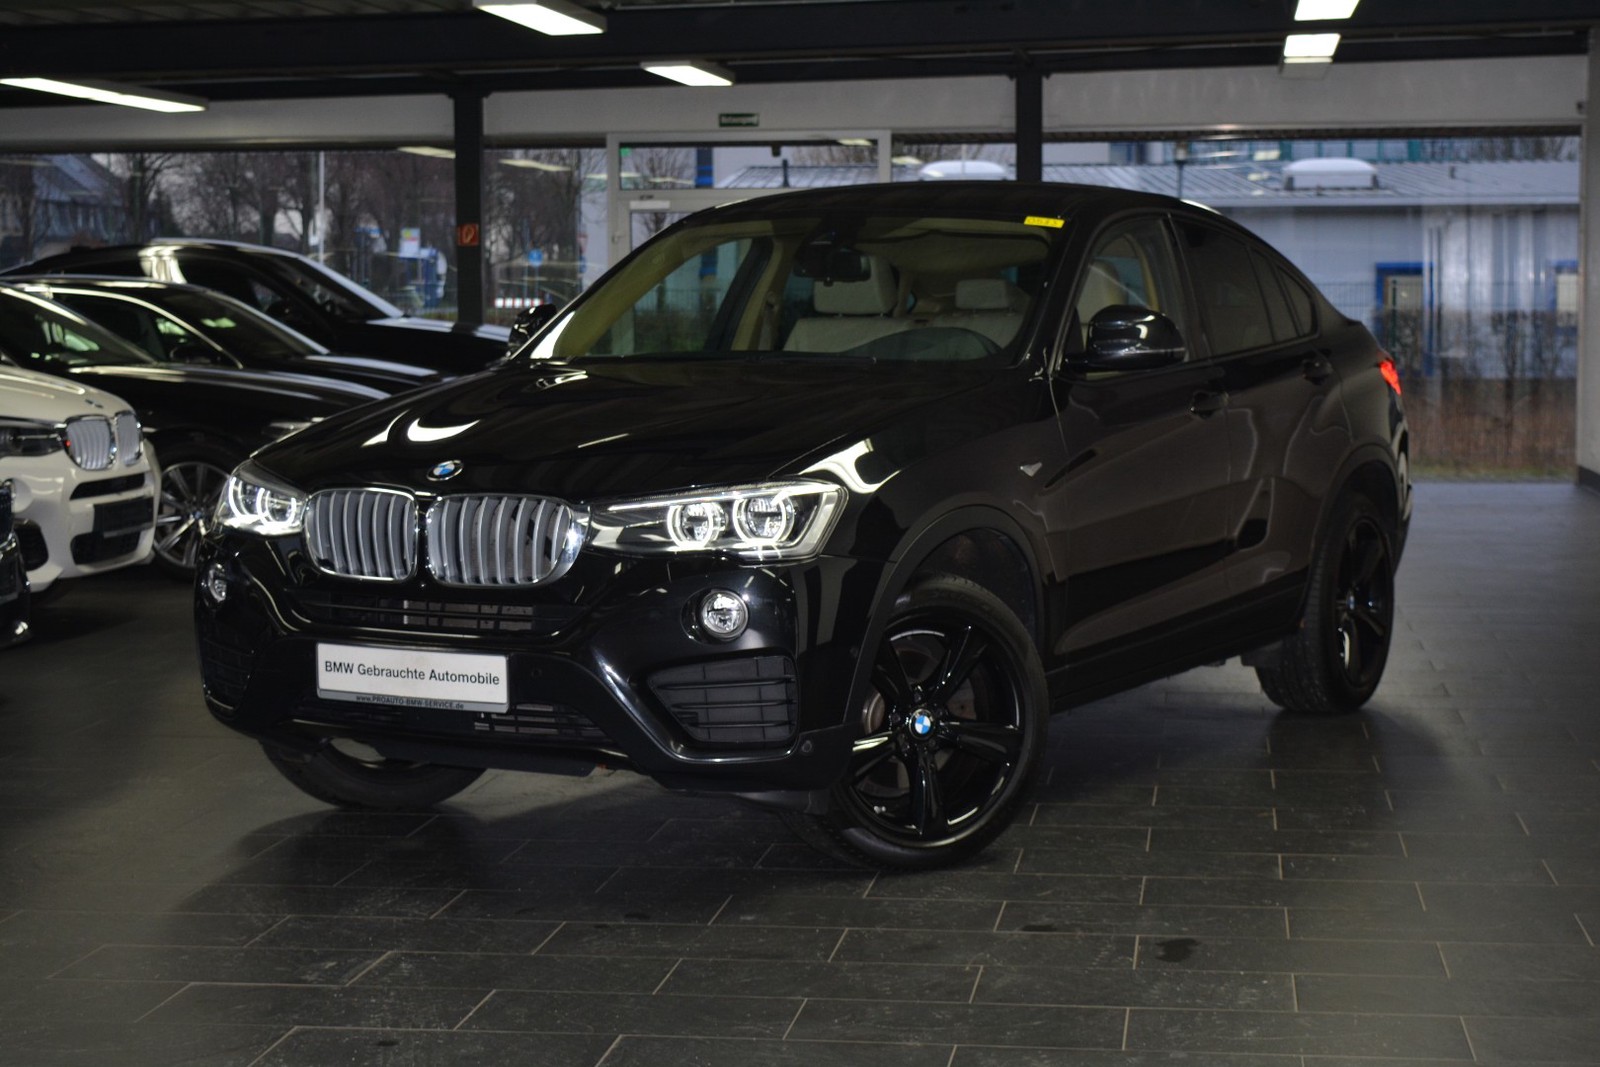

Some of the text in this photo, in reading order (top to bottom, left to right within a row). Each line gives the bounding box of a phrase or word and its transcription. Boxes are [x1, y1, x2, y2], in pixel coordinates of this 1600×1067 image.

[325, 660, 500, 685] BMW Gebrauchte Automobile
[356, 695, 464, 709] www.PROAUTO-BMW-SERVICE.de
